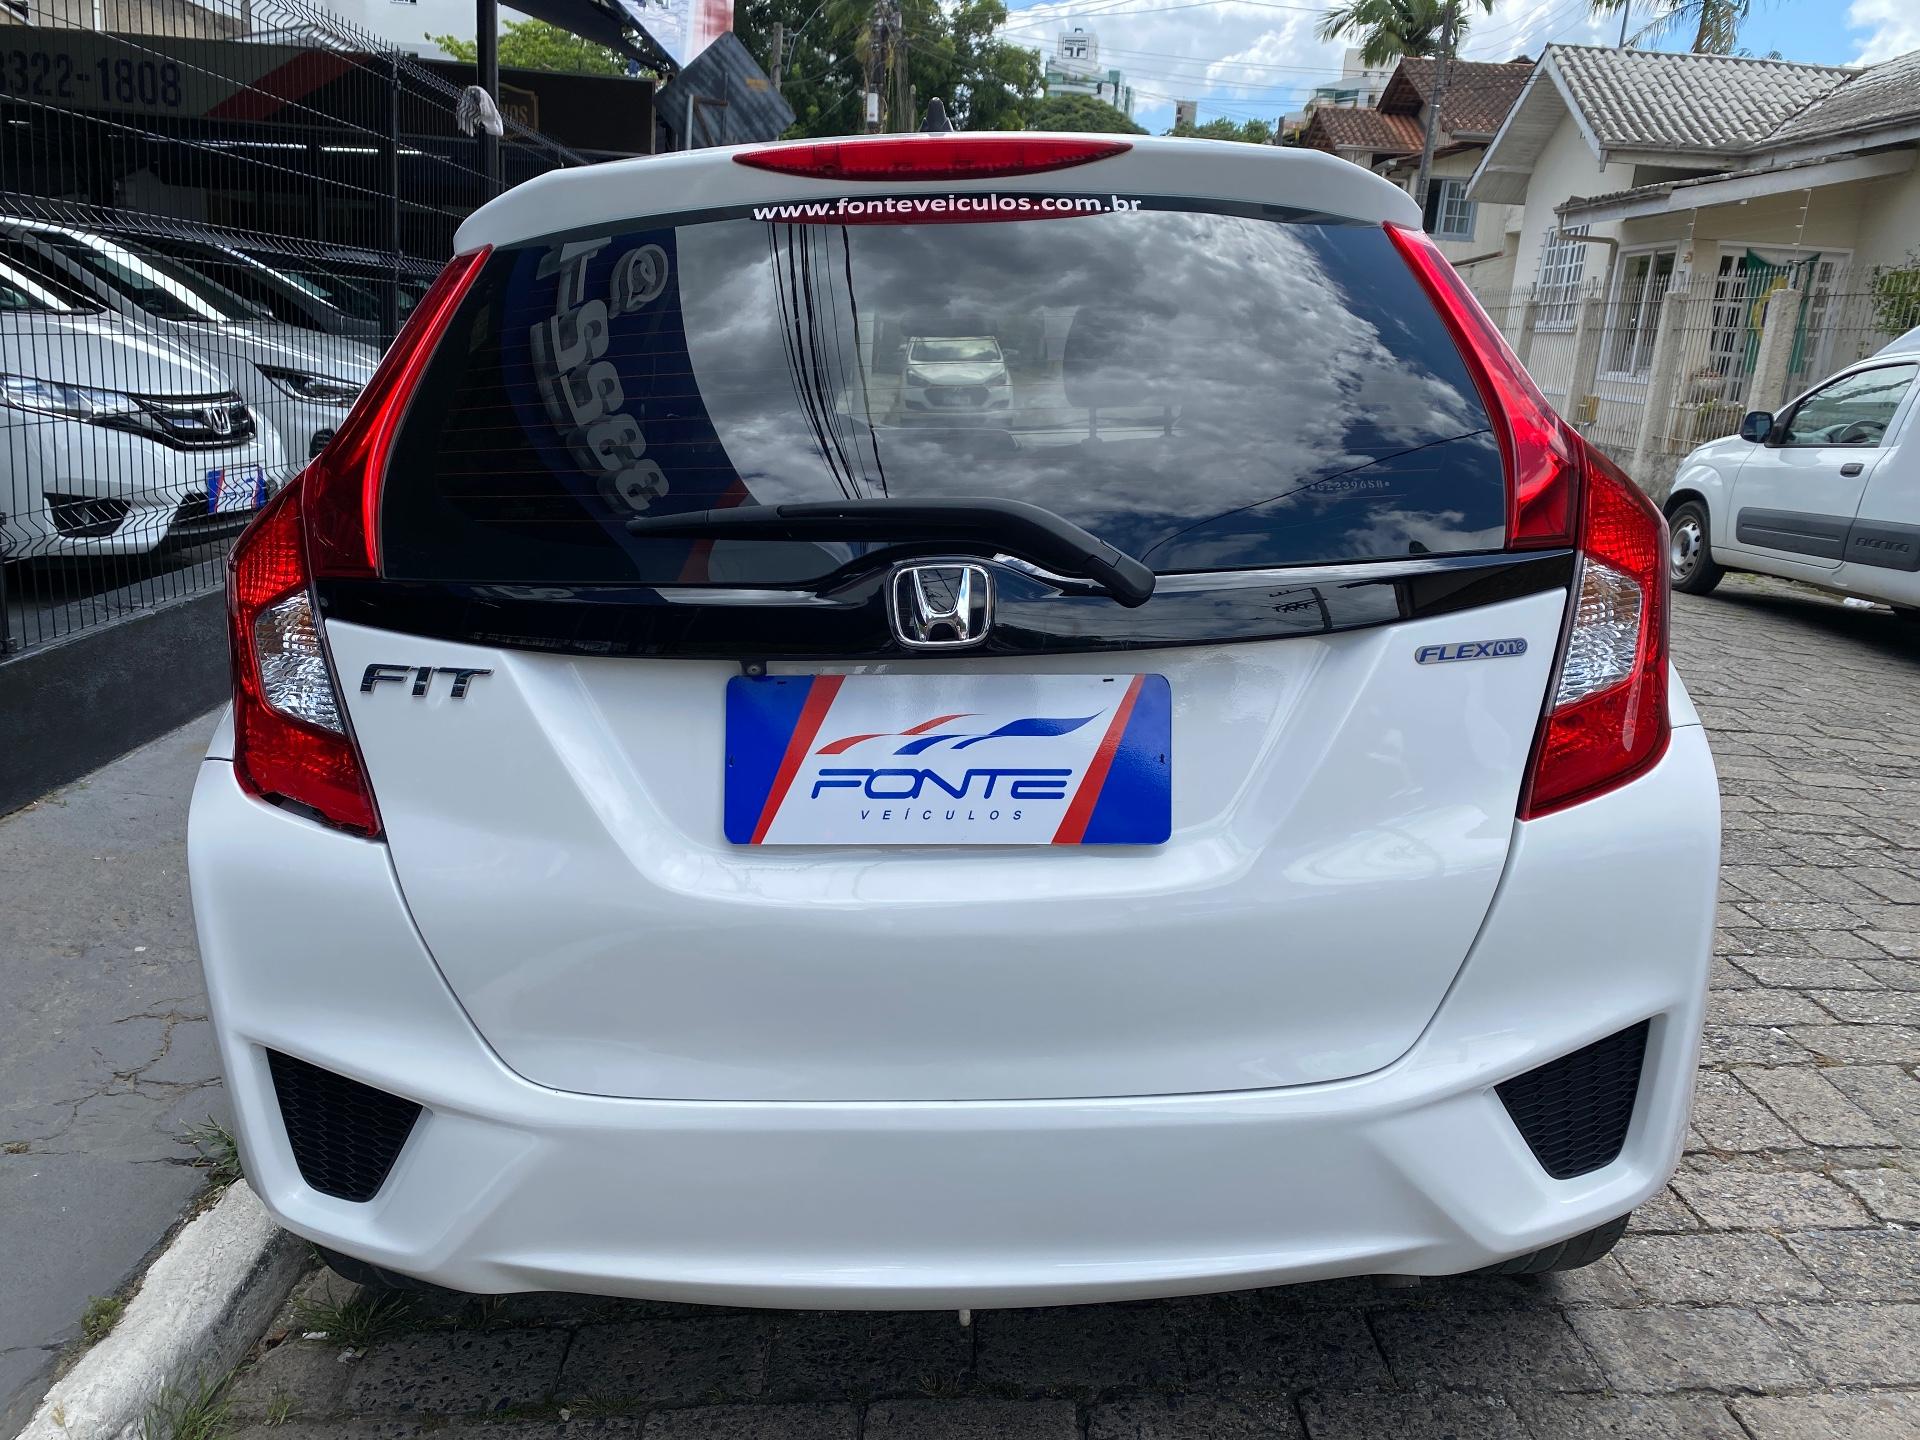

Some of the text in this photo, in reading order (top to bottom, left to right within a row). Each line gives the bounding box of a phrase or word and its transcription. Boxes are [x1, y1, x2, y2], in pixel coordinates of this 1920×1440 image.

[753, 194, 1142, 221] www.fonteveiculos.com.br
[359, 663, 495, 699] FIT
[811, 768, 1073, 800] FONTE
[860, 807, 1023, 821] VEÍCULOS
